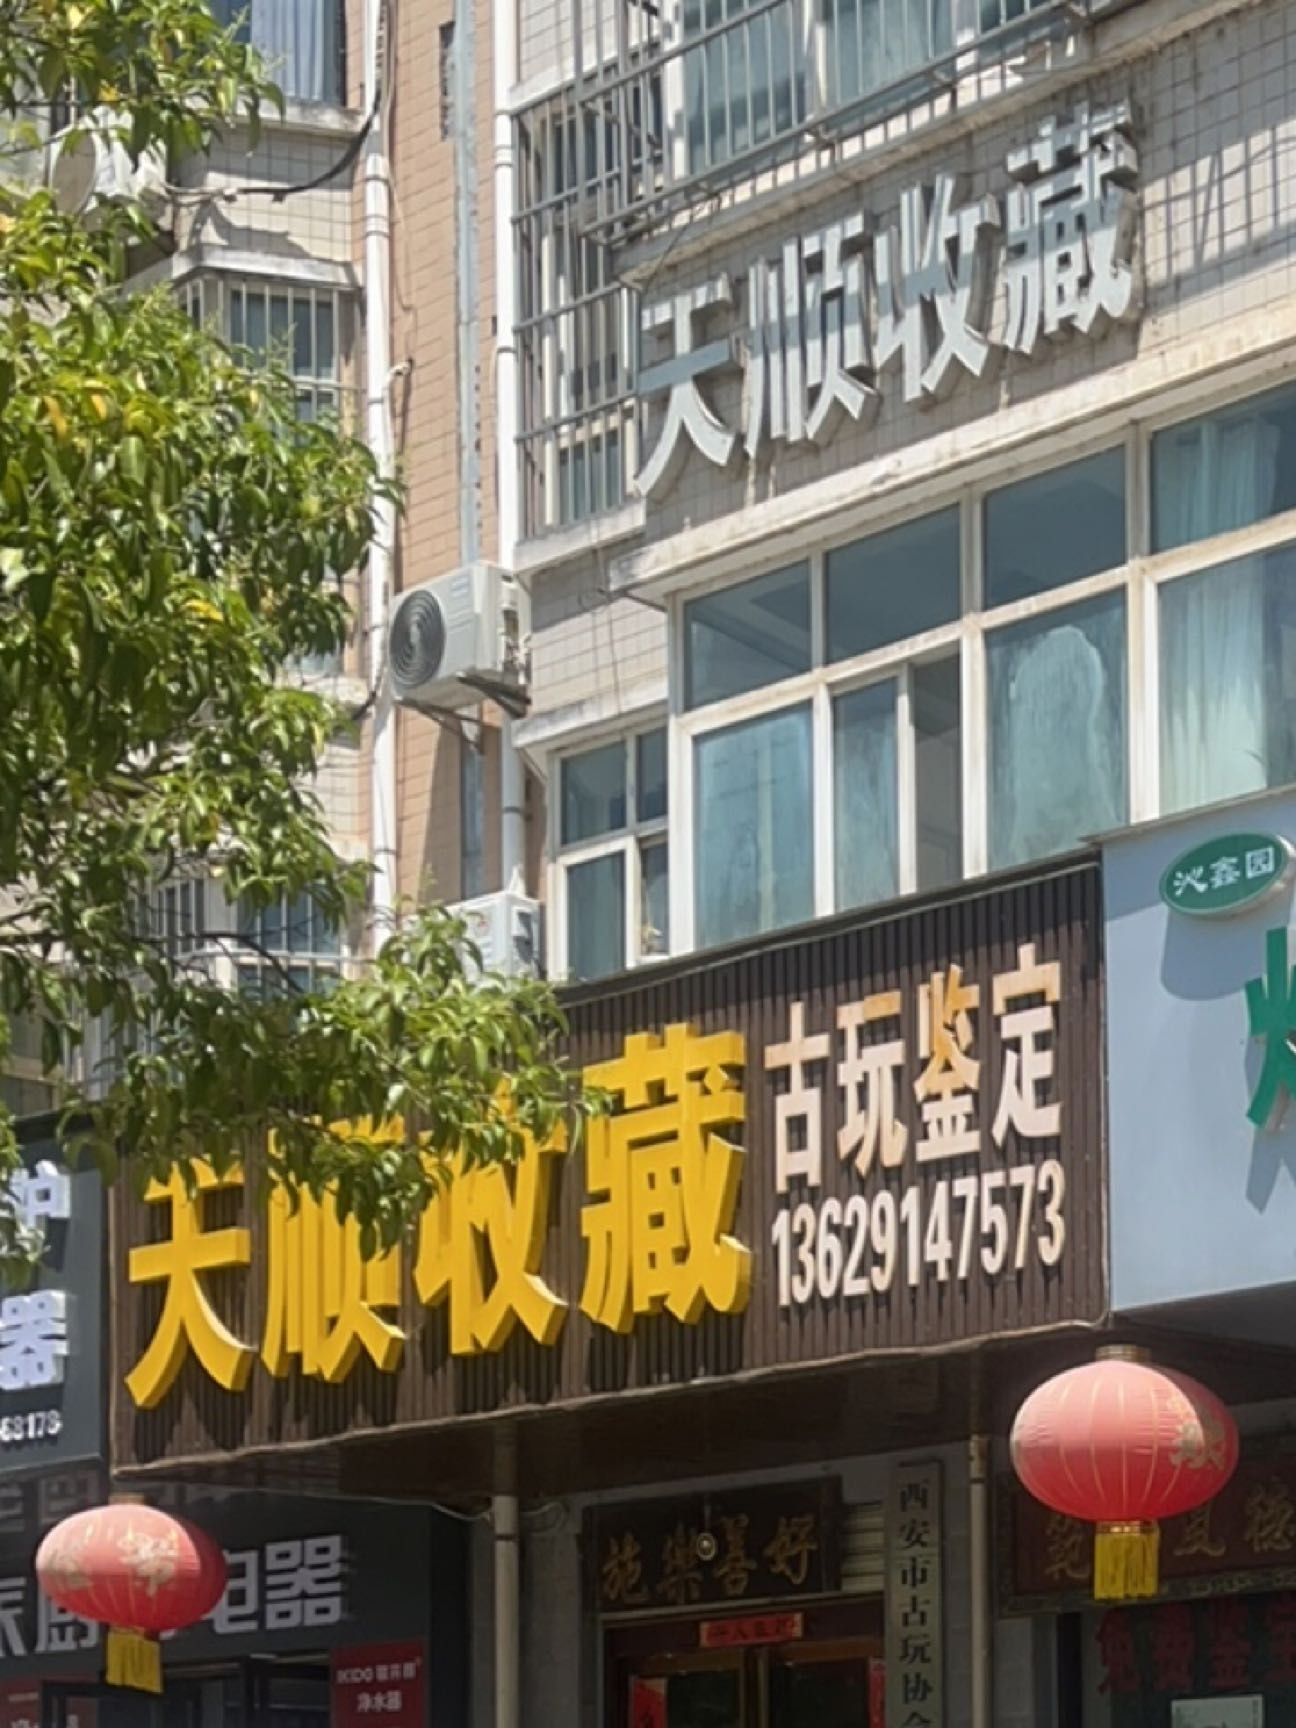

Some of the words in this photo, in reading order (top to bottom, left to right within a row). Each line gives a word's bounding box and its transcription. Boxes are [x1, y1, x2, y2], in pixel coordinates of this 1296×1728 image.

[634, 98, 1140, 497] 天顺收藏
[124, 1021, 754, 1411] 天顺收藏
[763, 944, 1064, 1194] 古玩鉴定
[770, 1158, 1066, 1306] 13629147573
